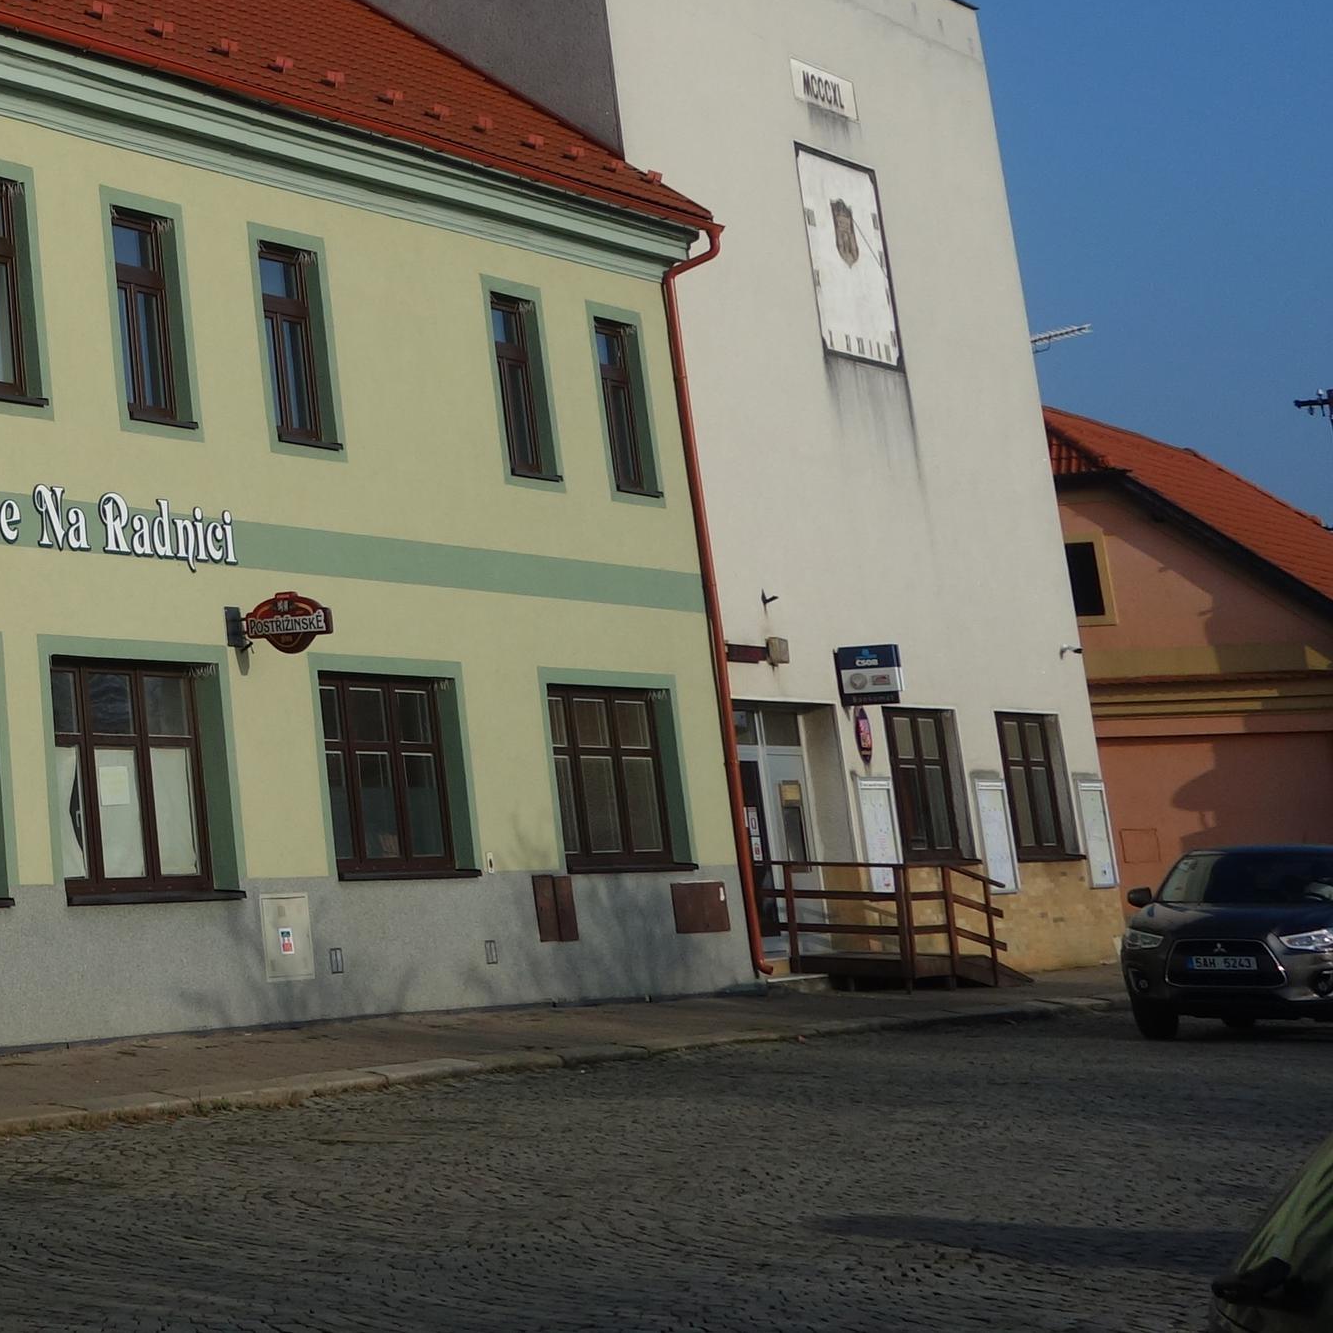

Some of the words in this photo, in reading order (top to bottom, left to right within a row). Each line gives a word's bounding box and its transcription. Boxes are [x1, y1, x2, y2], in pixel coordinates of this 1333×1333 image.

[802, 69, 844, 110] MCCCXL
[33, 484, 91, 551] Na
[98, 492, 238, 573] Radnici
